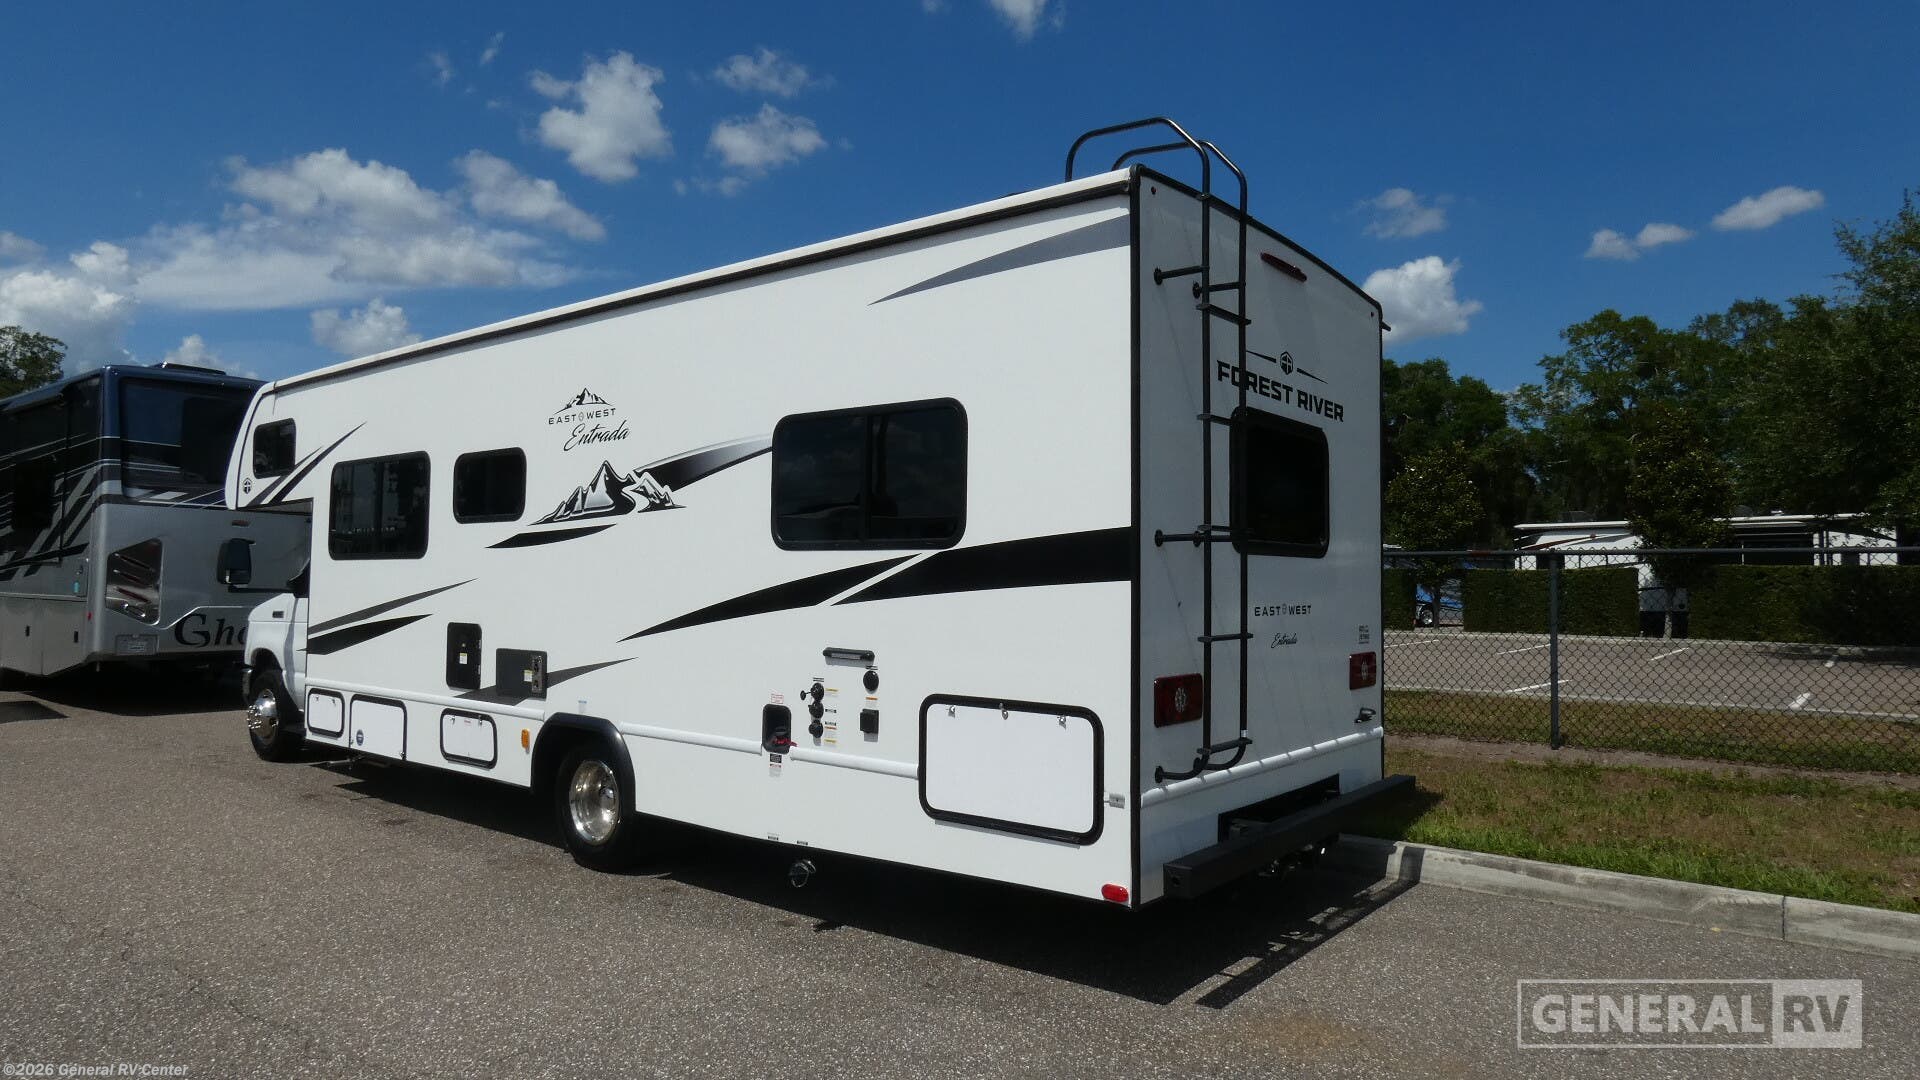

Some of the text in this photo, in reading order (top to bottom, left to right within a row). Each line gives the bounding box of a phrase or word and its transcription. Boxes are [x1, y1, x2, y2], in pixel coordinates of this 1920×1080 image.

[1217, 360, 1344, 422] FOREST RIVER
[548, 407, 616, 425] EAST WEST
[563, 419, 629, 452] Entrada
[1254, 605, 1312, 617] EAST WEST
